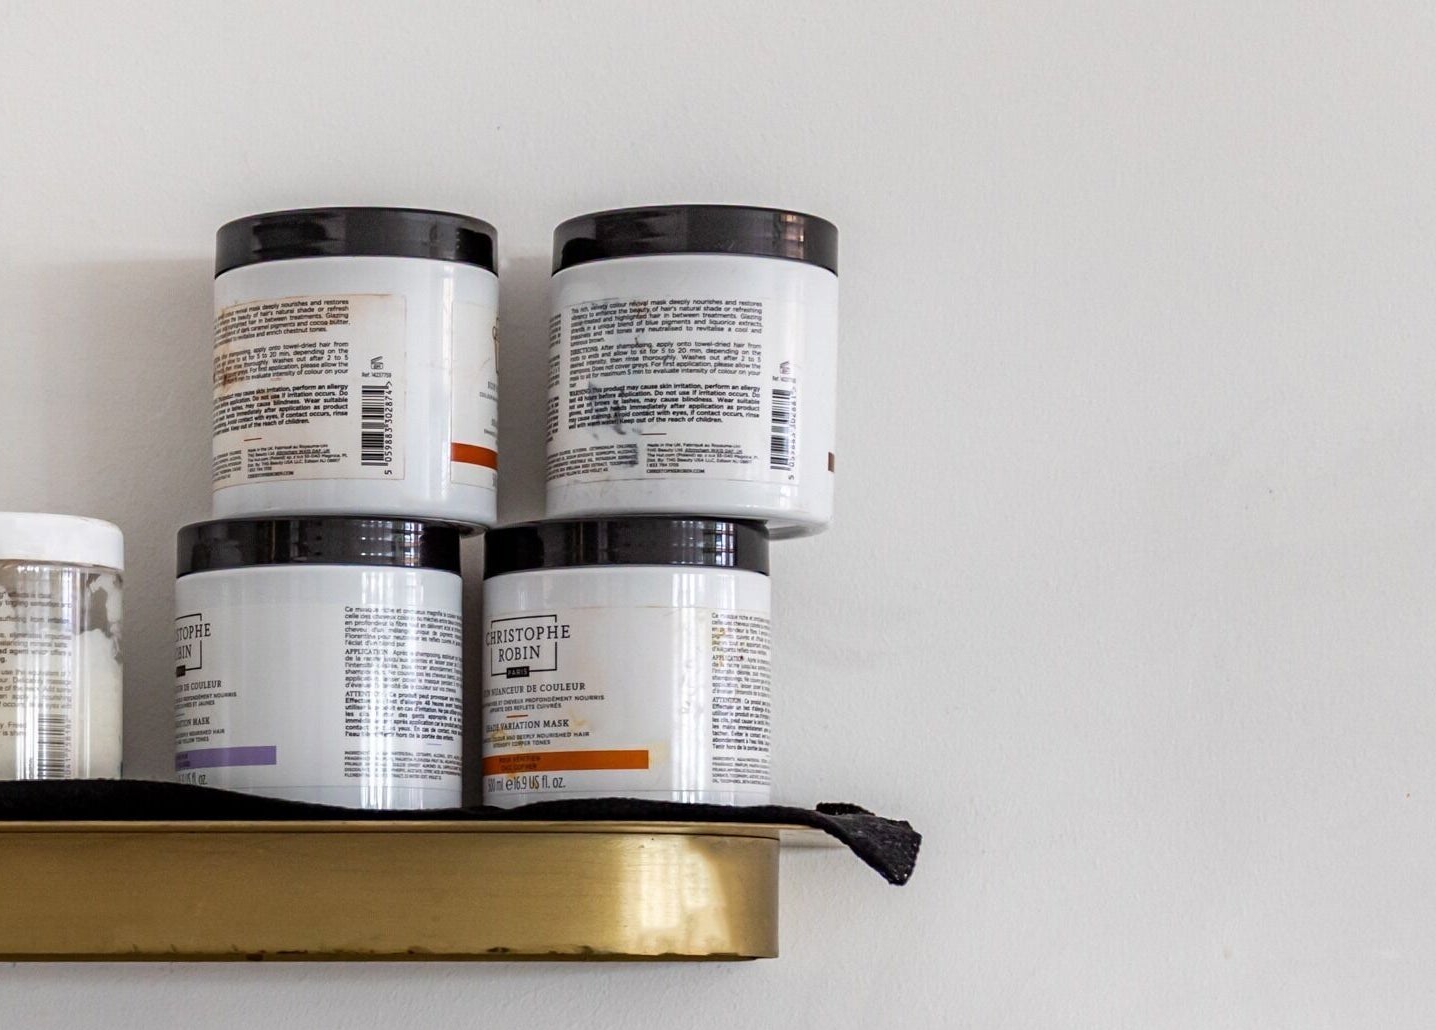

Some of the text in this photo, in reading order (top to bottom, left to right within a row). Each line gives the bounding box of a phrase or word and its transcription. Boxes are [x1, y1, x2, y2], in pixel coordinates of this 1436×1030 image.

[485, 624, 570, 646] CHRISTOPHE
[498, 646, 540, 662] ROBIN
[540, 683, 586, 692] COULEUR
[529, 776, 539, 789] US
[553, 778, 565, 788] oz.
